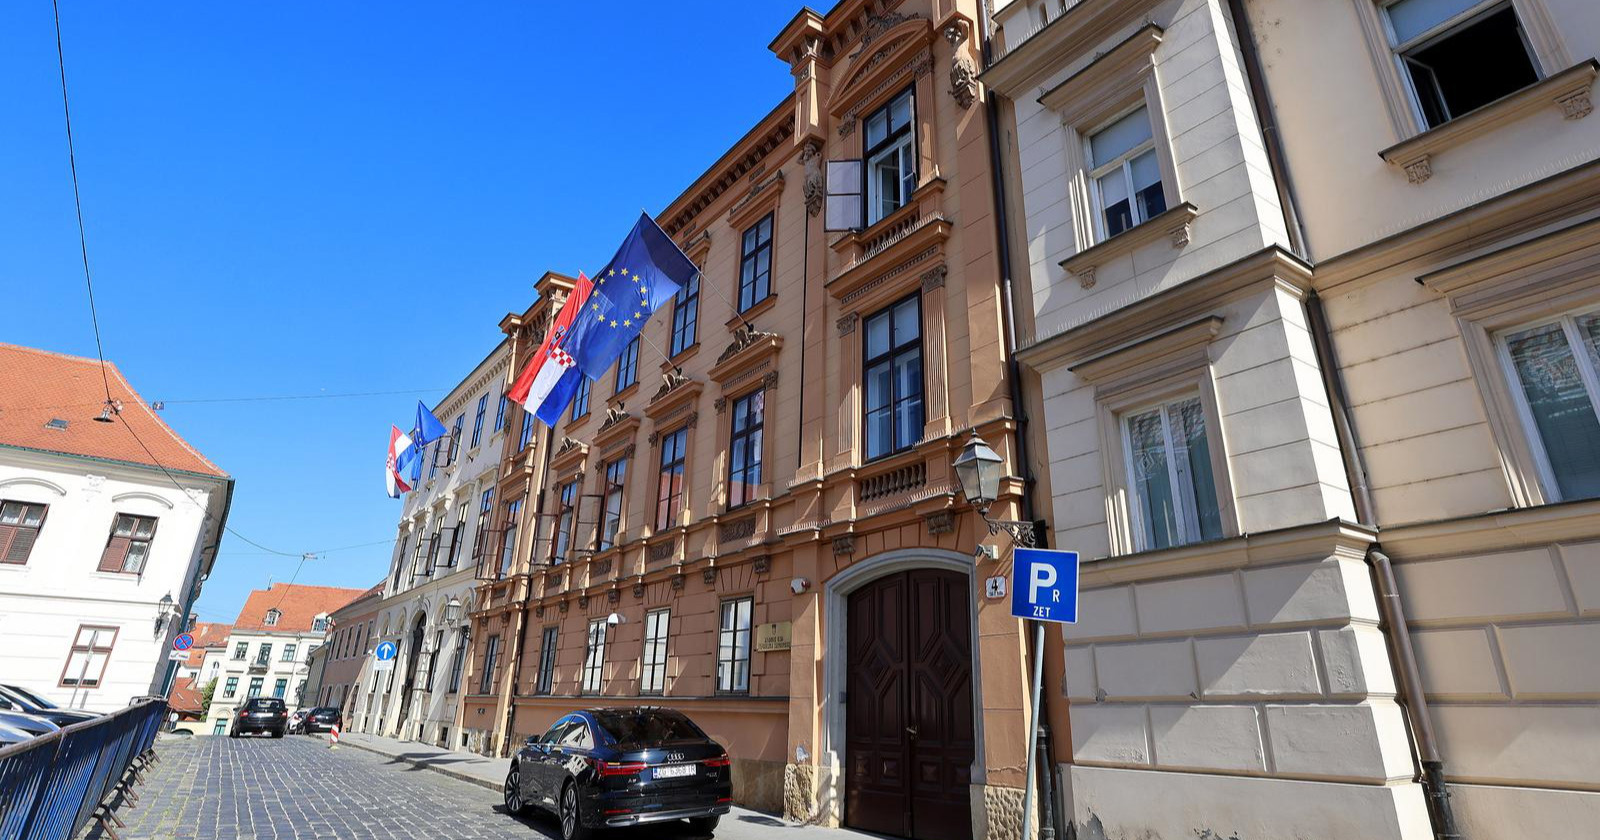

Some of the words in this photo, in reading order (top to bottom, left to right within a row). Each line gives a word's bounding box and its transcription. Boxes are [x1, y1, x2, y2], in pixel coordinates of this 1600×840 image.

[991, 578, 998, 591] 4
[1029, 562, 1057, 604] P
[1053, 589, 1060, 603] R
[1033, 606, 1050, 617] ZET
